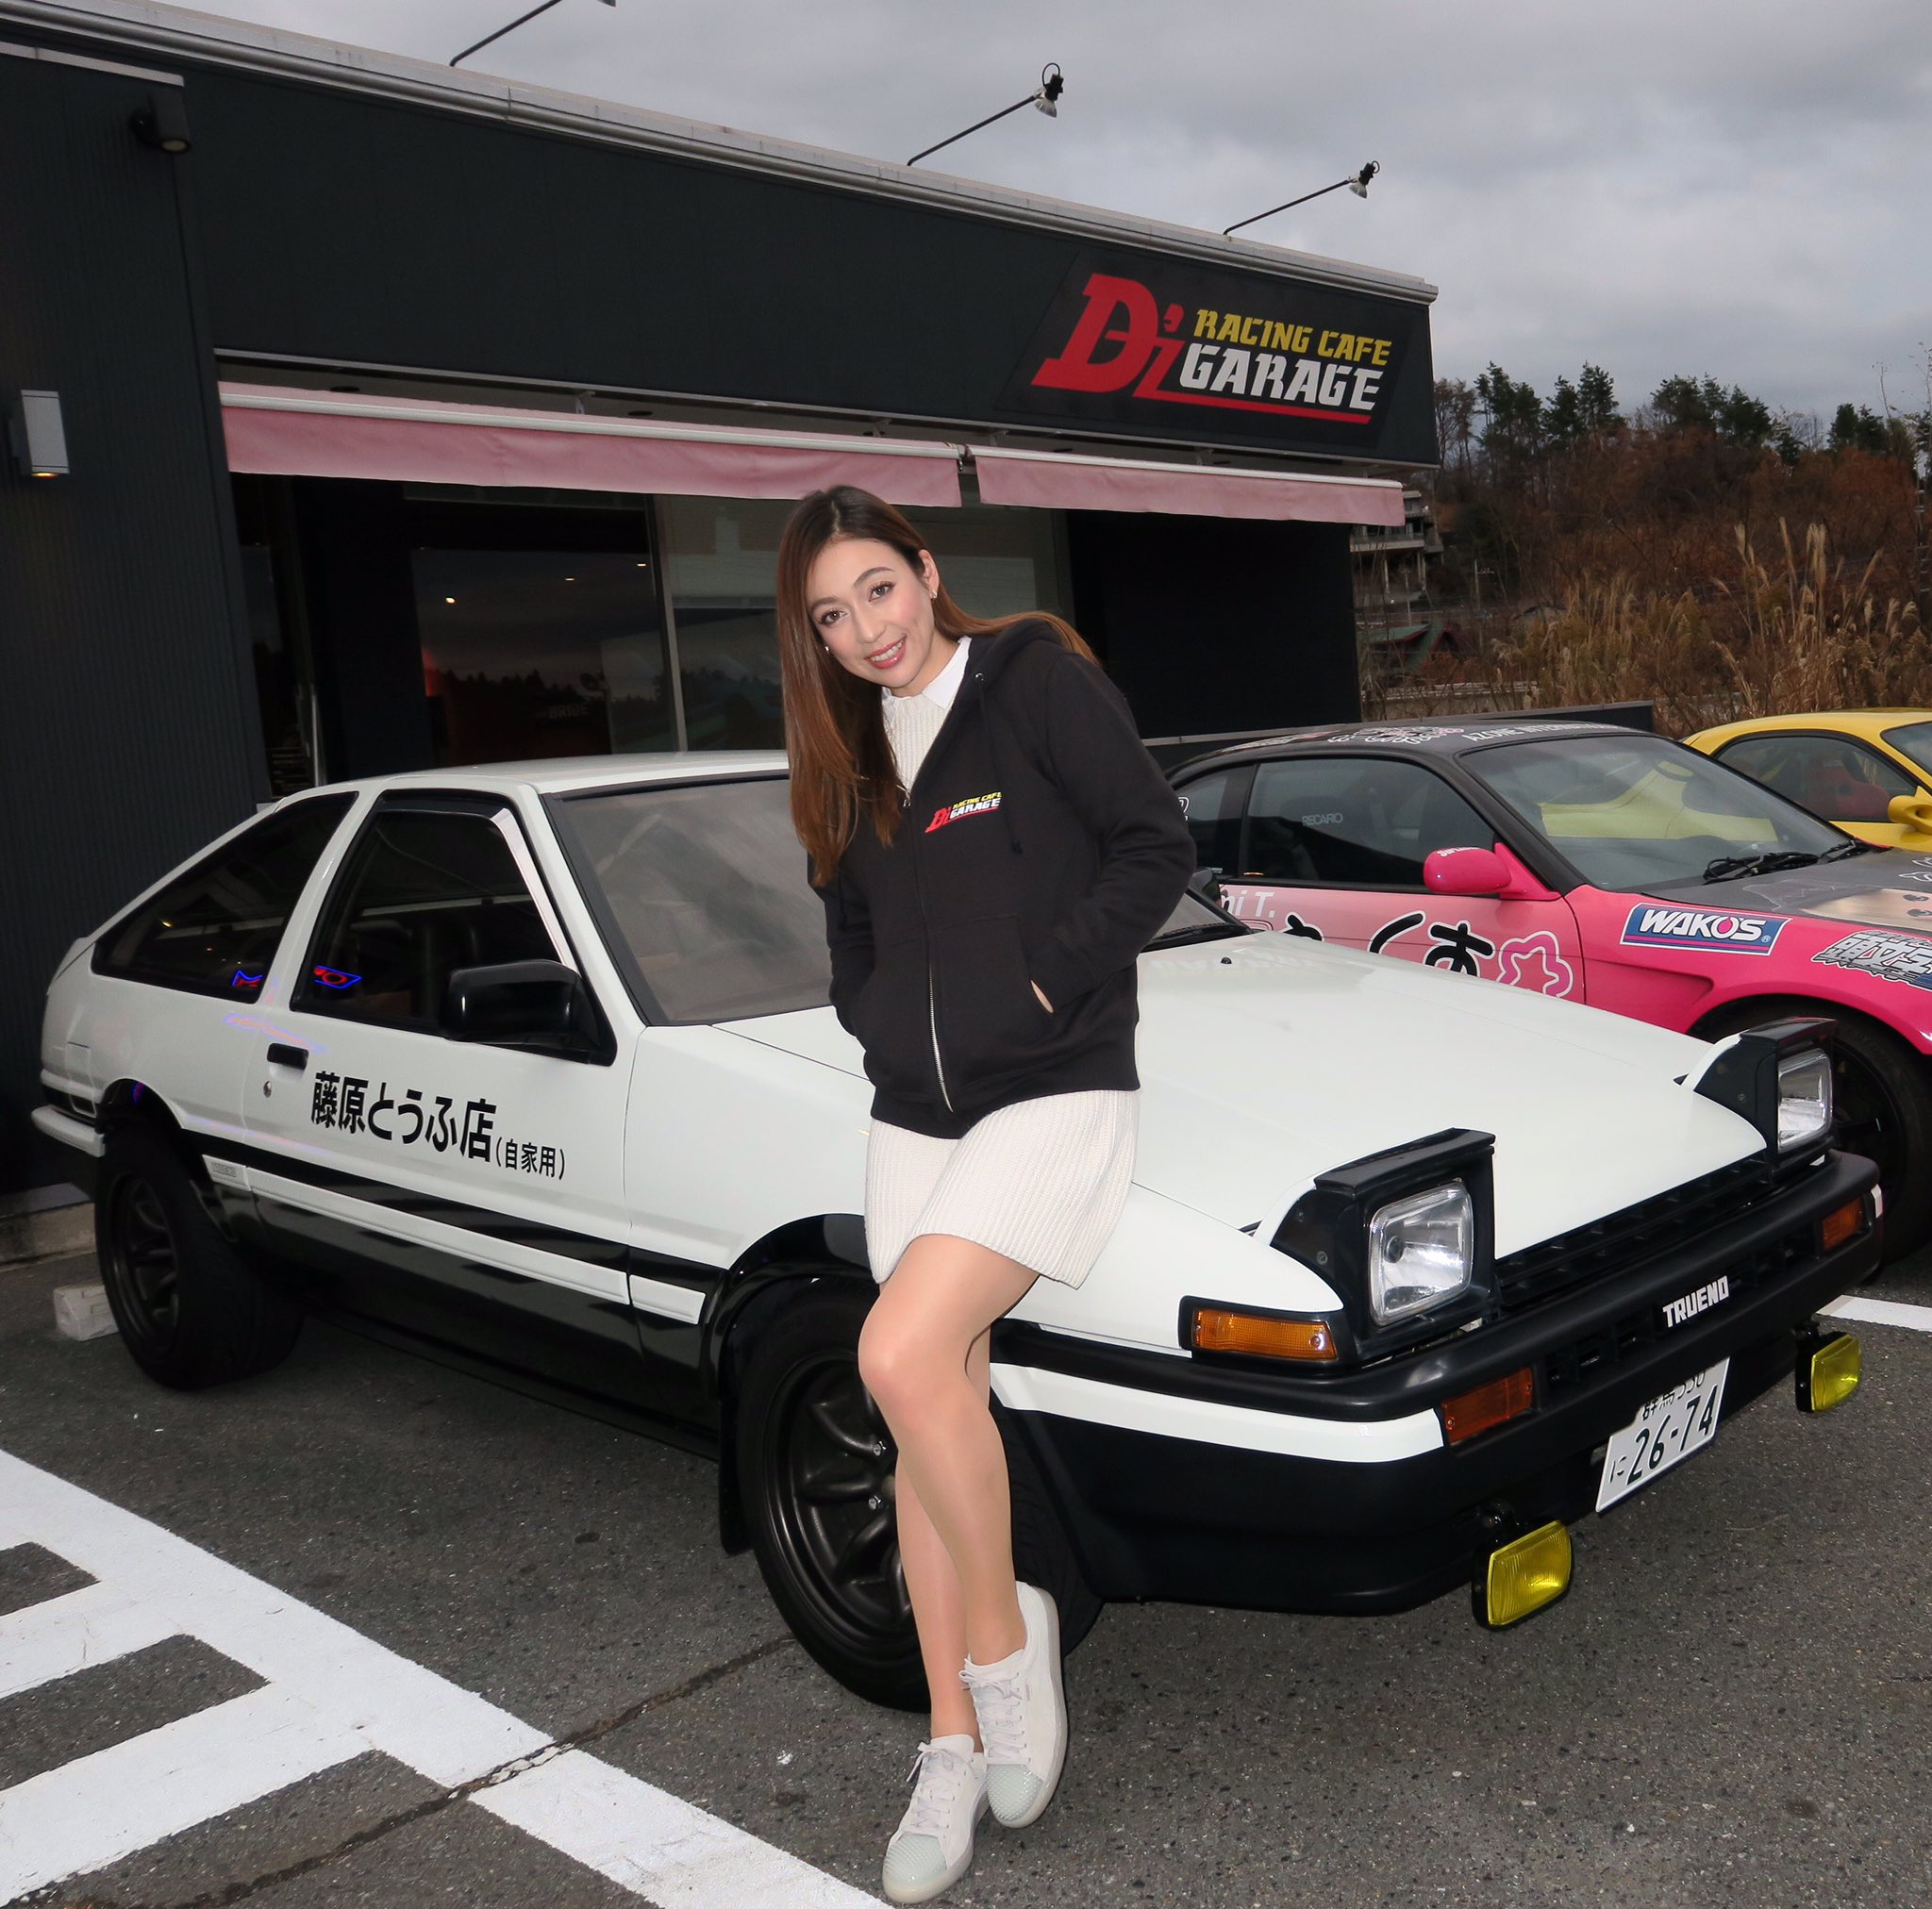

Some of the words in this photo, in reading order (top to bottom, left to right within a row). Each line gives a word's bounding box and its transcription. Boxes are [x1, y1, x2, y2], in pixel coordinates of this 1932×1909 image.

[1193, 308, 1312, 354] RACING
[1317, 330, 1392, 367] CAFE
[1179, 342, 1384, 411] GARAGE
[949, 797, 1001, 819] GARAGE
[952, 796, 981, 810] RACING
[1302, 812, 1343, 827] RECARO
[310, 1071, 497, 1163] 藤原とうふ店
[1662, 1275, 1730, 1327] TRUENO
